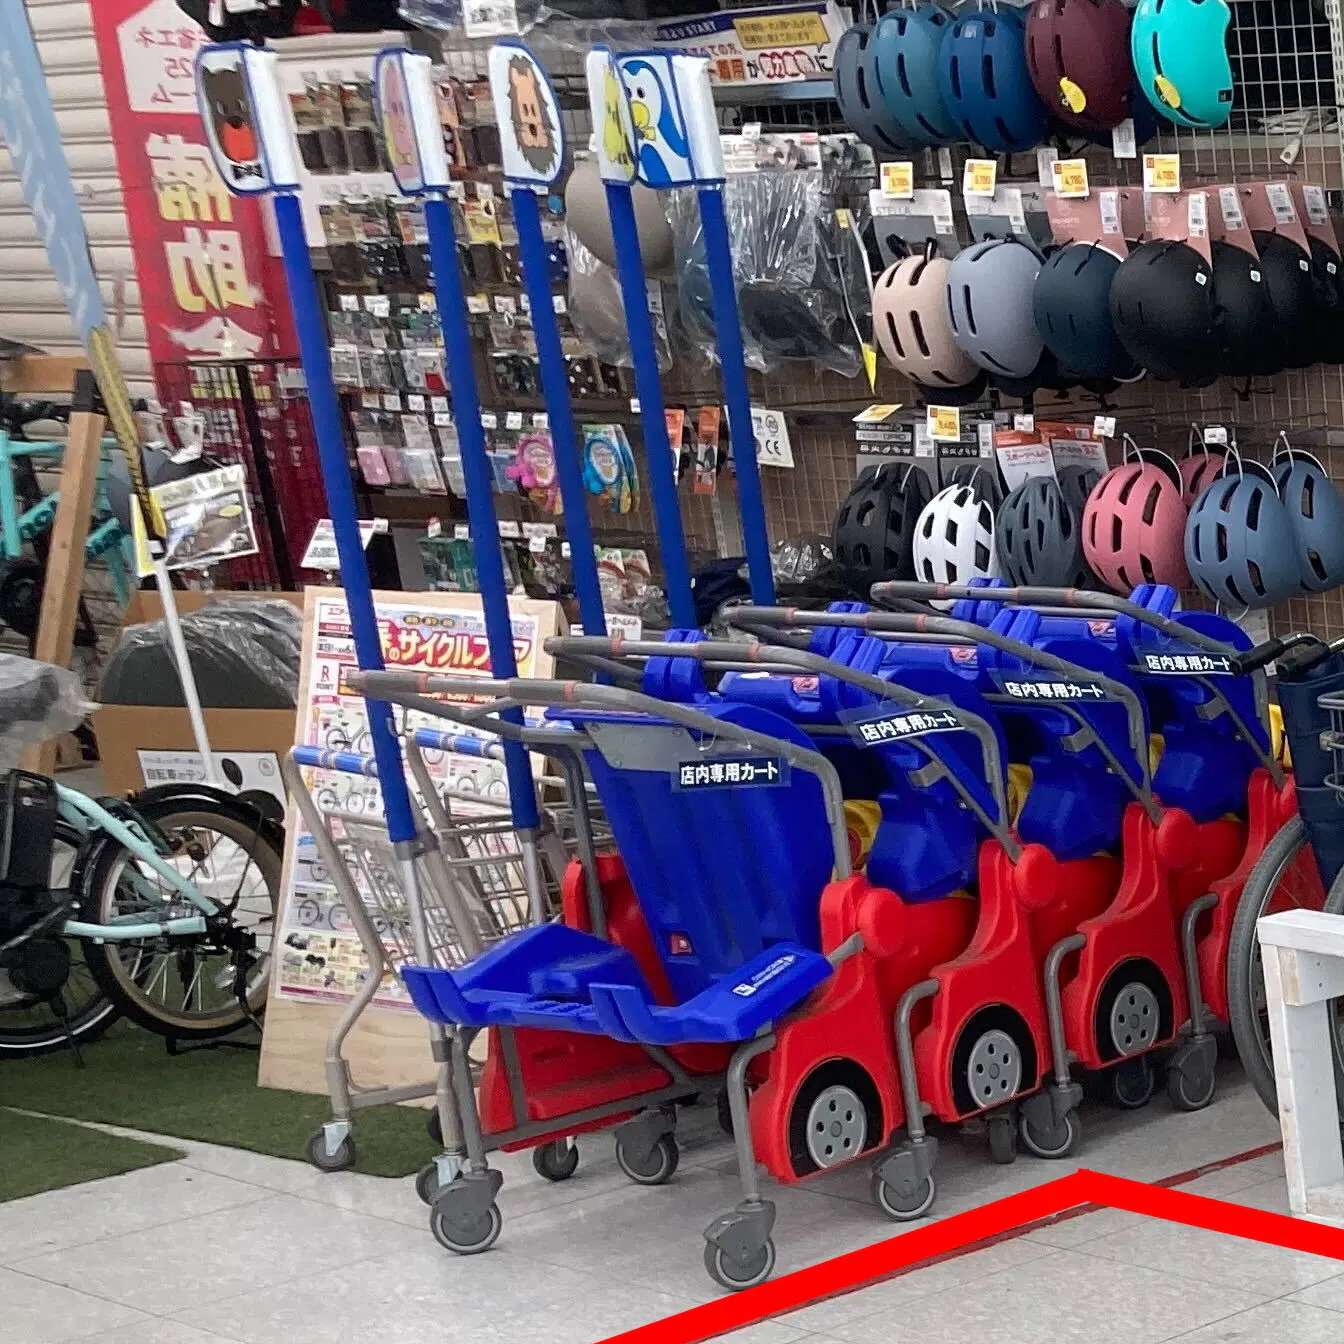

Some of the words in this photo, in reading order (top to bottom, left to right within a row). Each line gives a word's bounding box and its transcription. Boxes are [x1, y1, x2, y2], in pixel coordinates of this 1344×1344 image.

[1145, 655, 1230, 671] 店内専用カート
[1005, 682, 1104, 698] 店内専用カート
[860, 712, 957, 741] 店内専用カート
[681, 761, 778, 785] 店内専用カート
